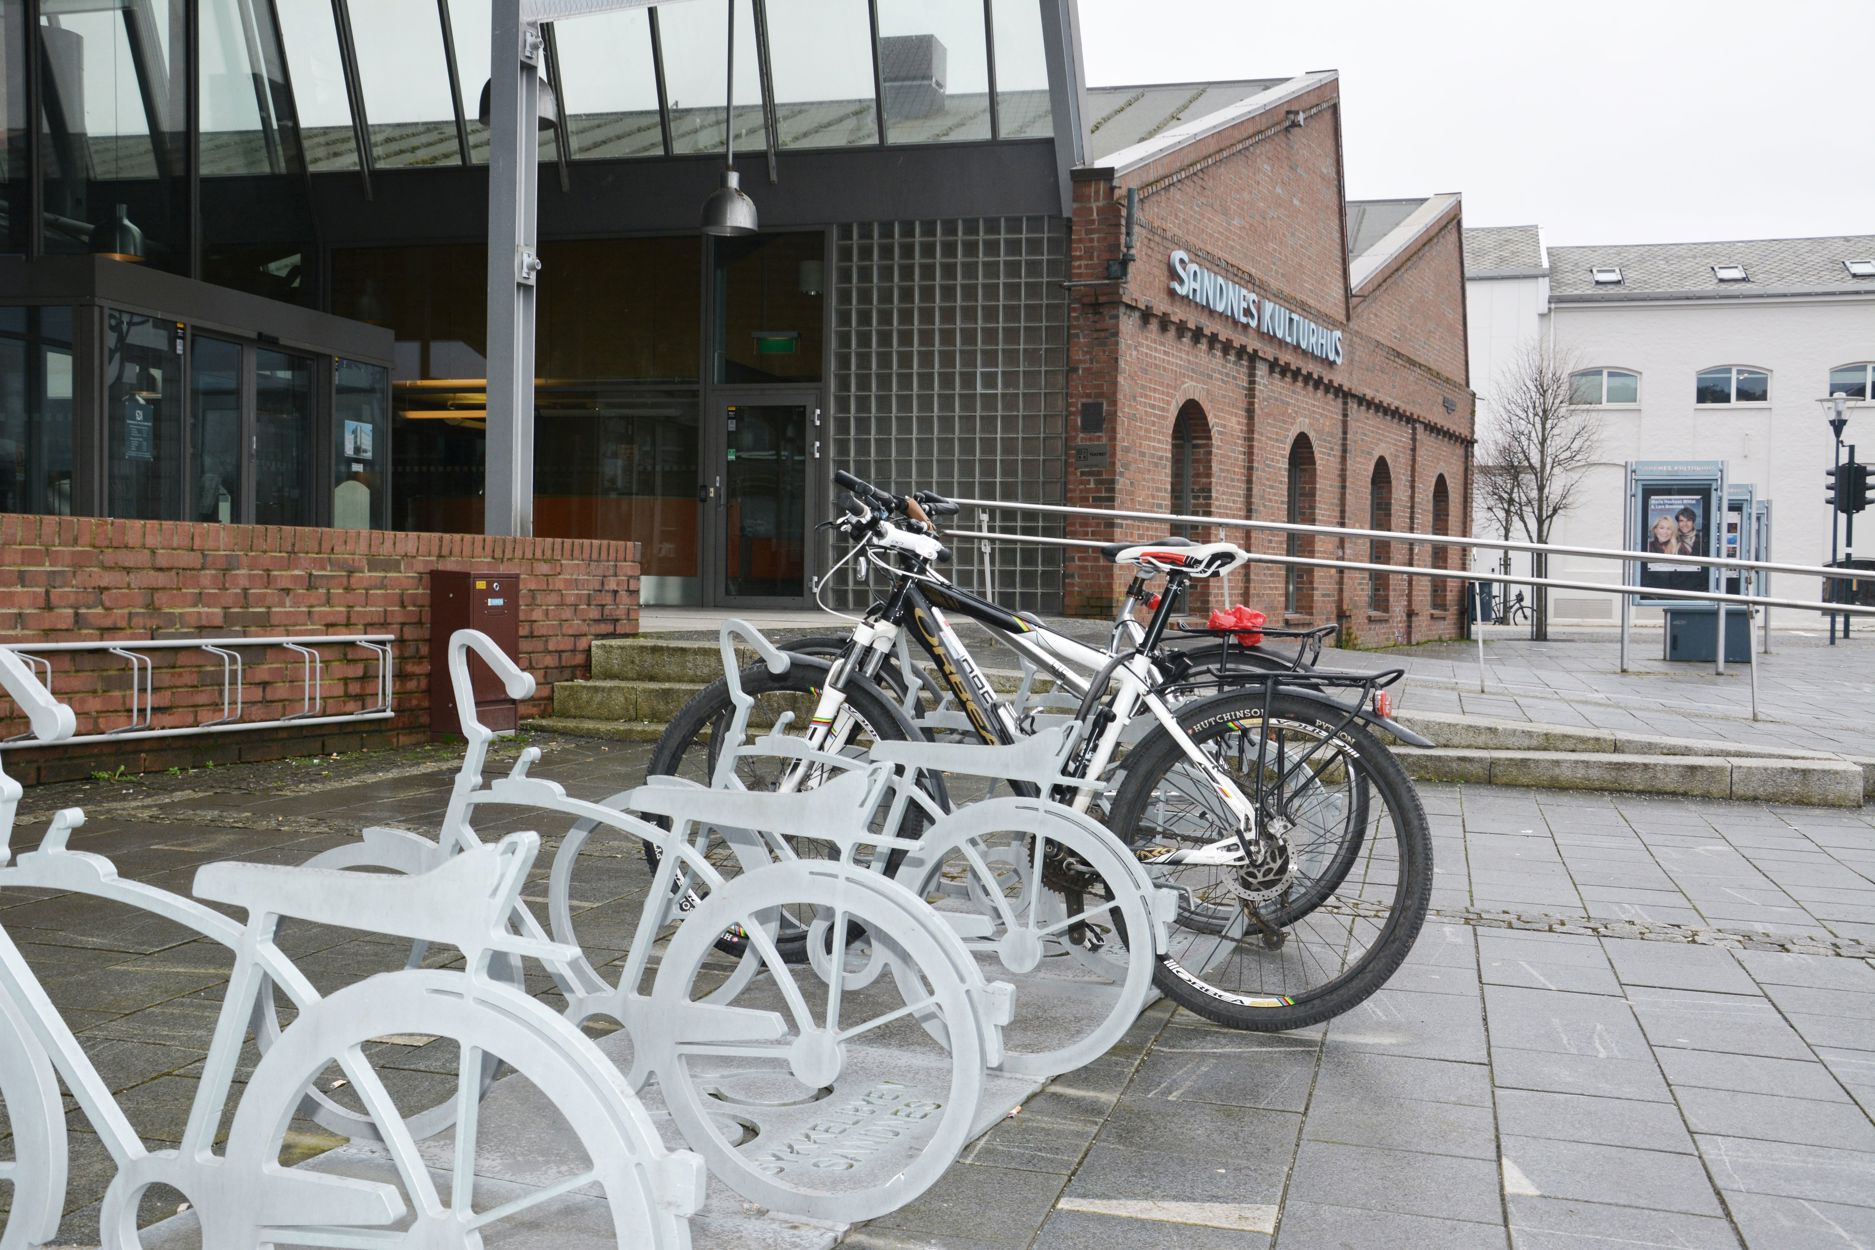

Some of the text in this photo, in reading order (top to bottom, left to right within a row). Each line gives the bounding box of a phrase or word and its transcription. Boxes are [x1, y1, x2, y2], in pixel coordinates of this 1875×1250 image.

[1170, 250, 1344, 365] SANDNES KULTURHUS
[914, 607, 998, 746] ORBEA
[1315, 719, 1357, 745] PYTON
